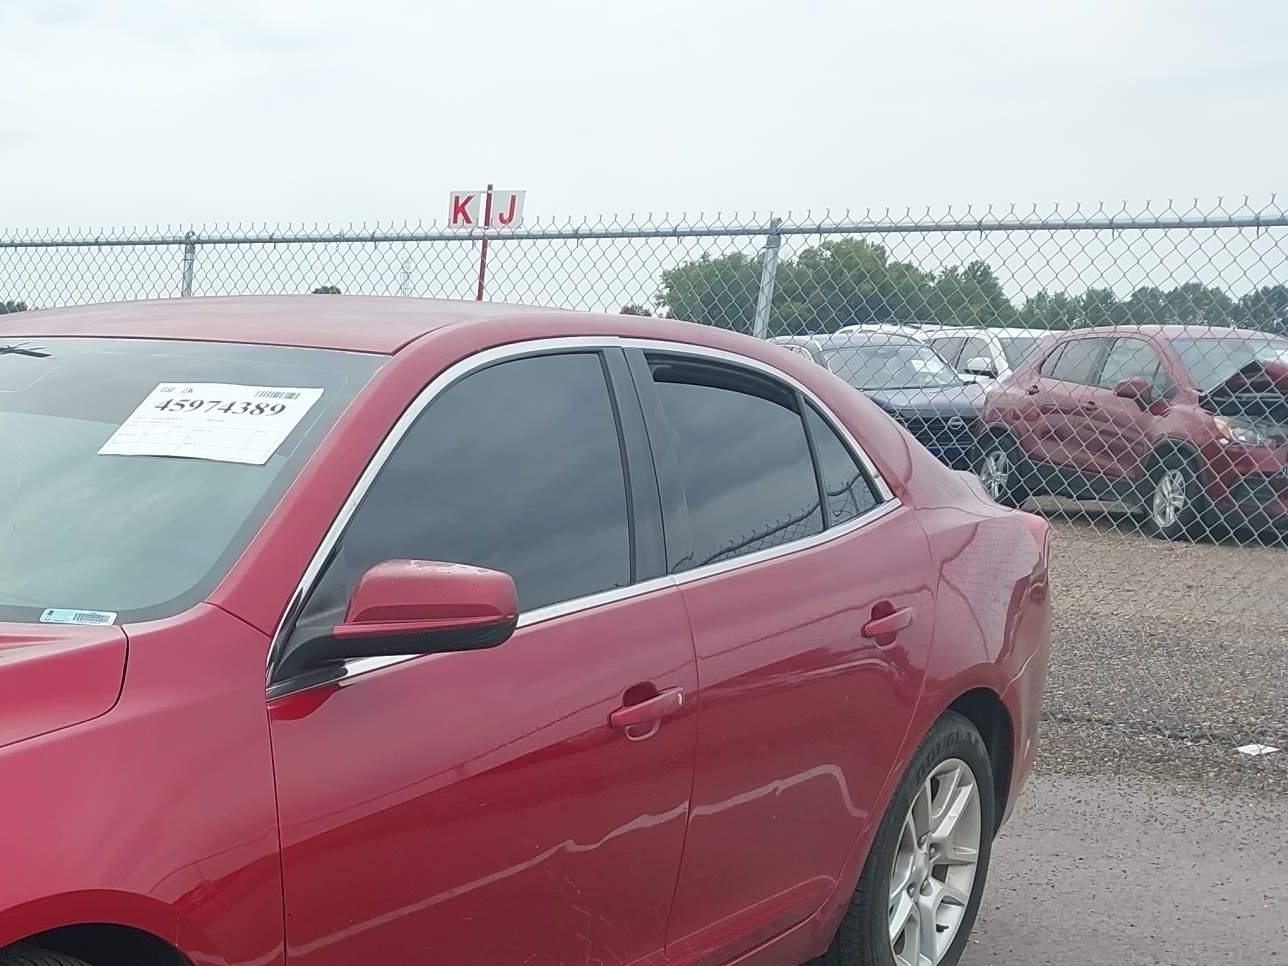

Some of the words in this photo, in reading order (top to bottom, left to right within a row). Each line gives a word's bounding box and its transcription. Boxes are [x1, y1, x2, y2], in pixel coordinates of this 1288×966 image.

[452, 195, 474, 225] K
[498, 194, 517, 225] J
[154, 398, 287, 417] 45974389
